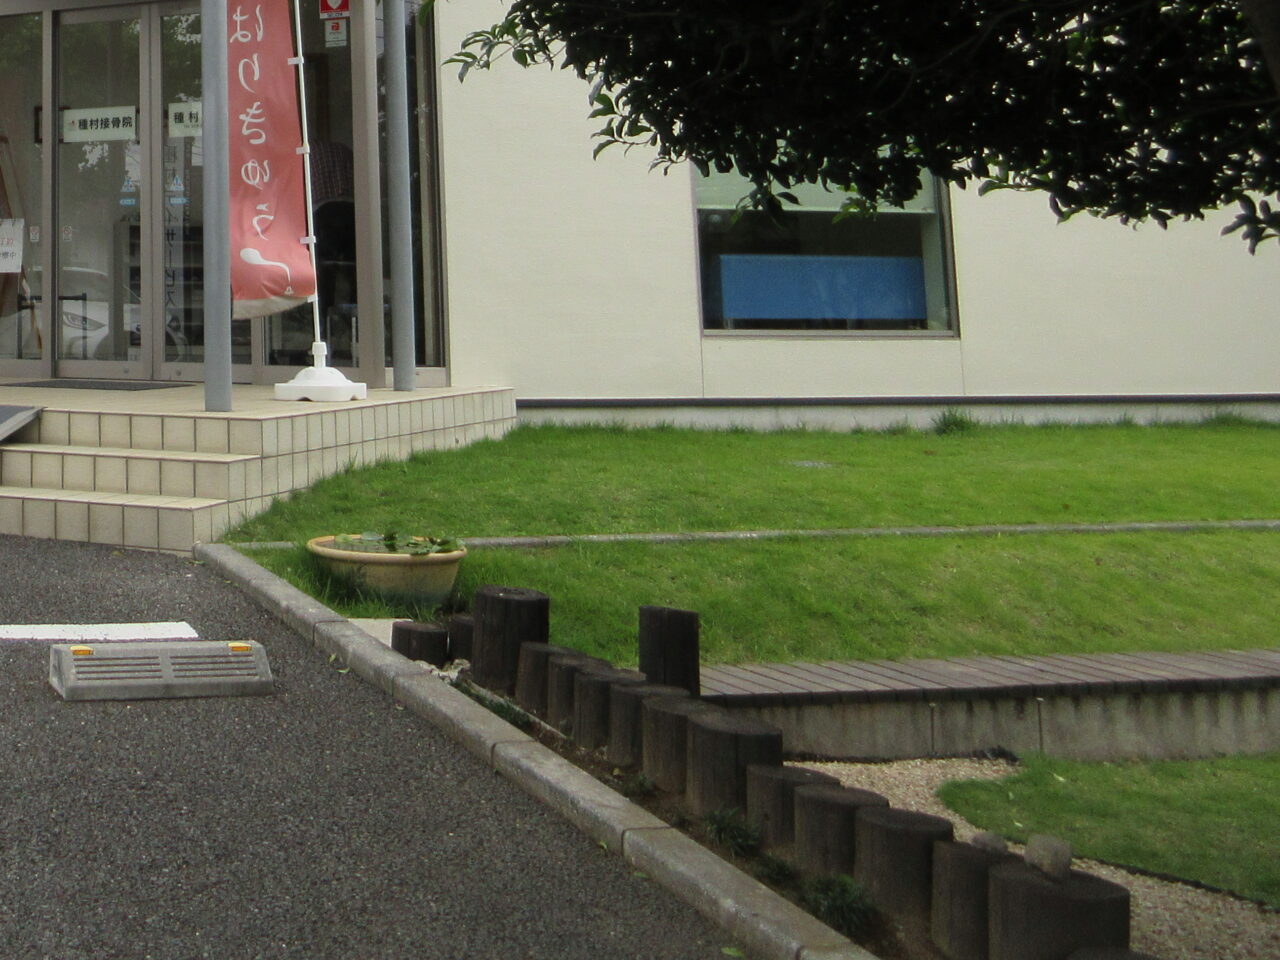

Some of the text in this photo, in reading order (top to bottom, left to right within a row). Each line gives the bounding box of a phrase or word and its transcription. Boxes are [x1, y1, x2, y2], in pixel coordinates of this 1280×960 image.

[78, 116, 133, 131] 種村接骨院
